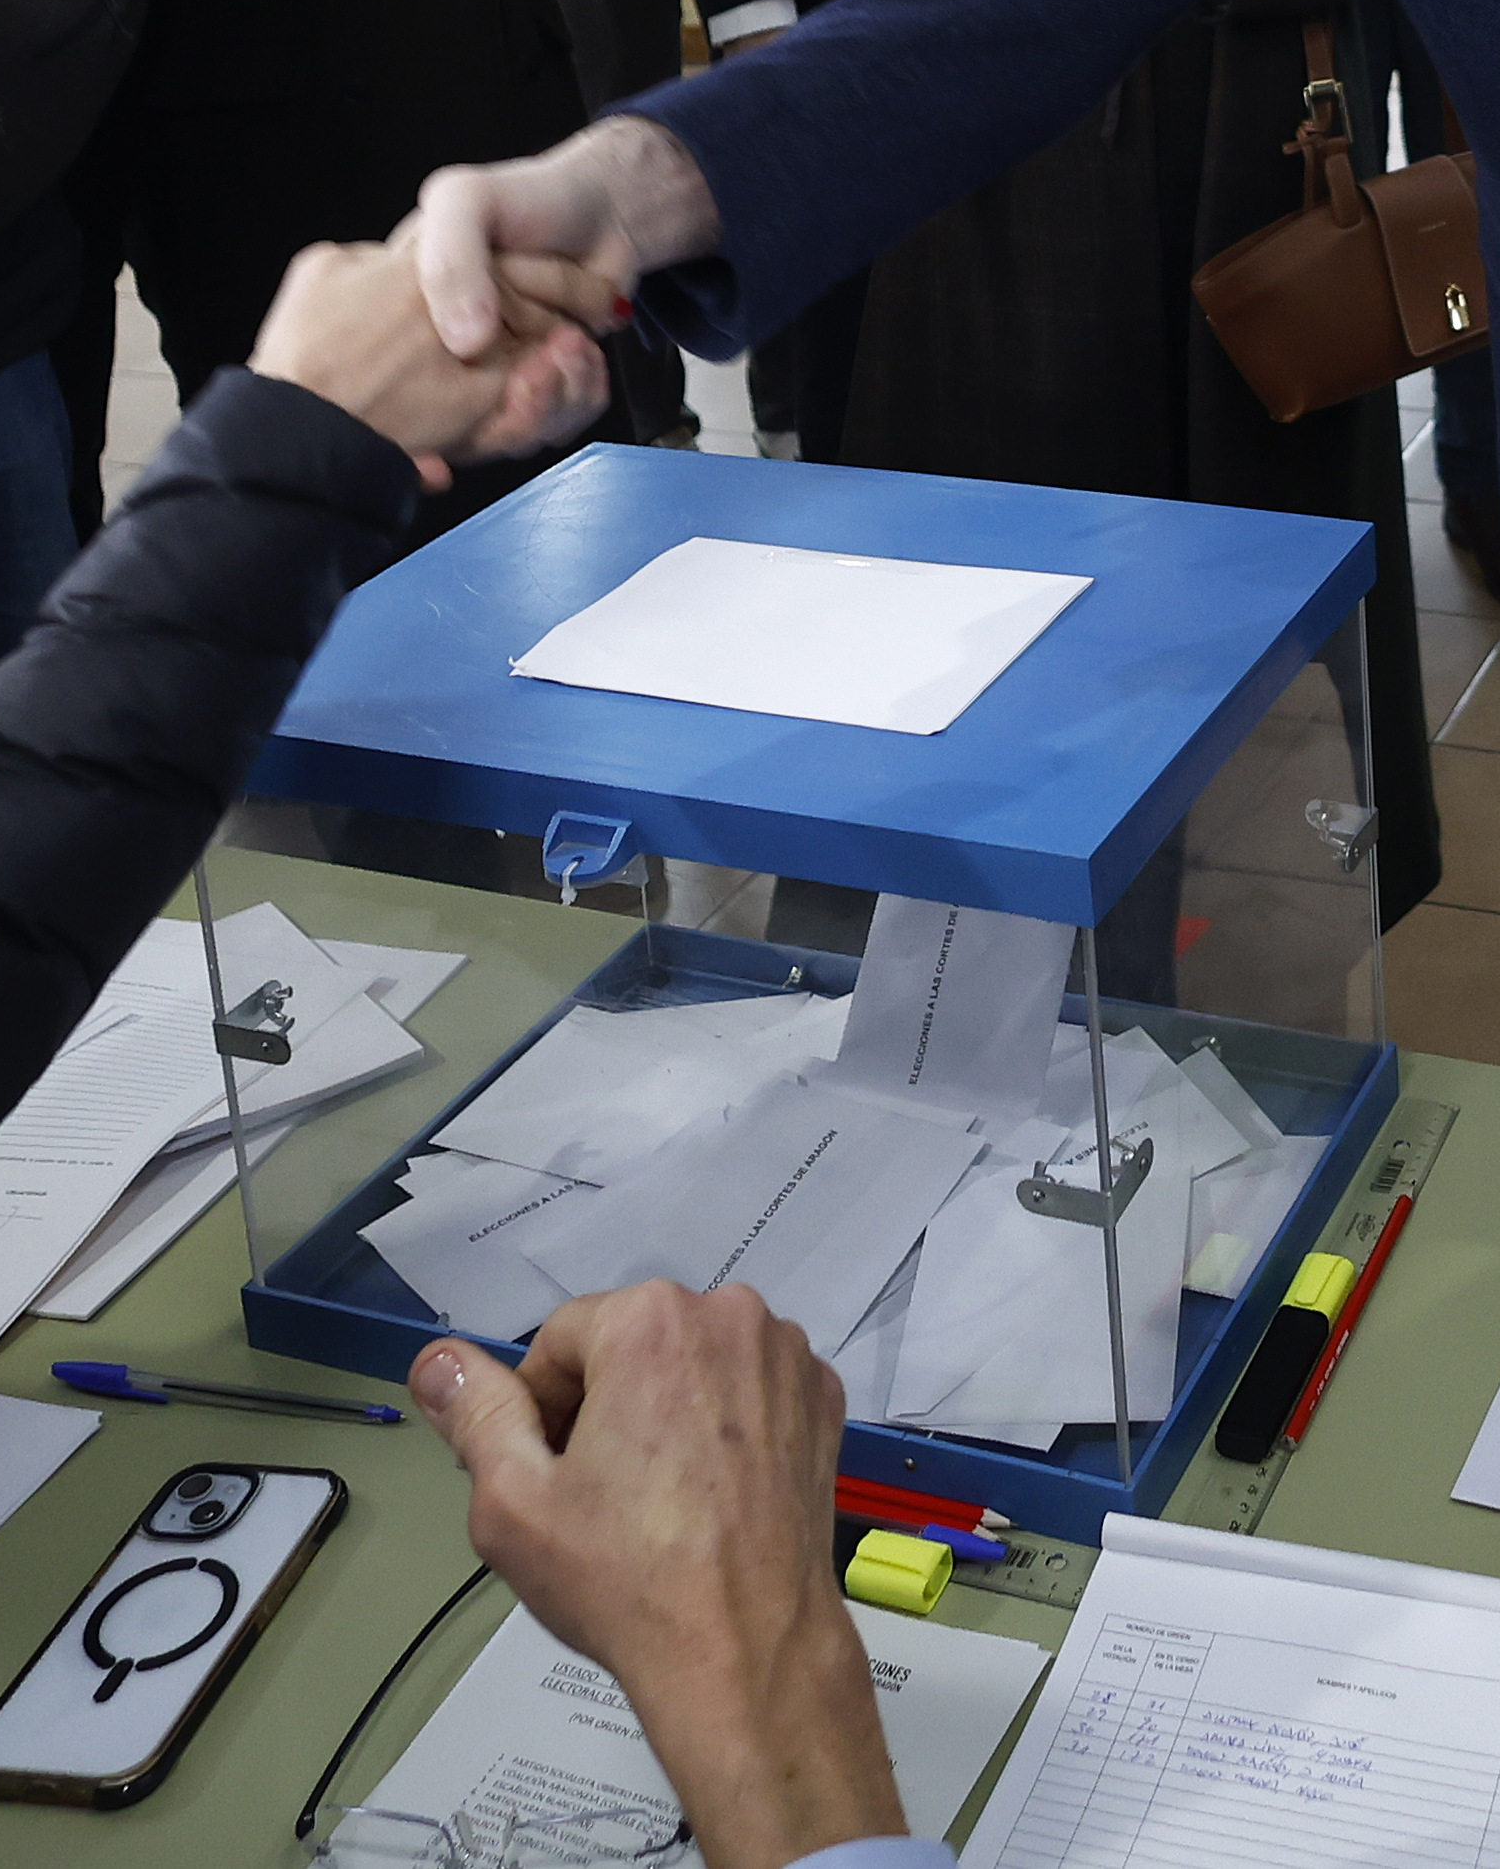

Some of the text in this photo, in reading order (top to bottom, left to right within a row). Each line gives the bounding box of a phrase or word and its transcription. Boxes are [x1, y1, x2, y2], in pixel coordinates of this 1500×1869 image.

[909, 910, 959, 1086] ELECCIONES A LAS CORTES DE
[468, 1184, 574, 1243] ELECCIONES A LAS
[742, 1238, 752, 1248] A
[748, 1218, 767, 1239] LAS
[764, 1181, 797, 1219] CORTES
[793, 1166, 808, 1182] DE
[540, 1676, 600, 1703] ELECTORAL
[552, 1662, 600, 1683] LISTADO
[595, 1720, 630, 1738] ORDEN
